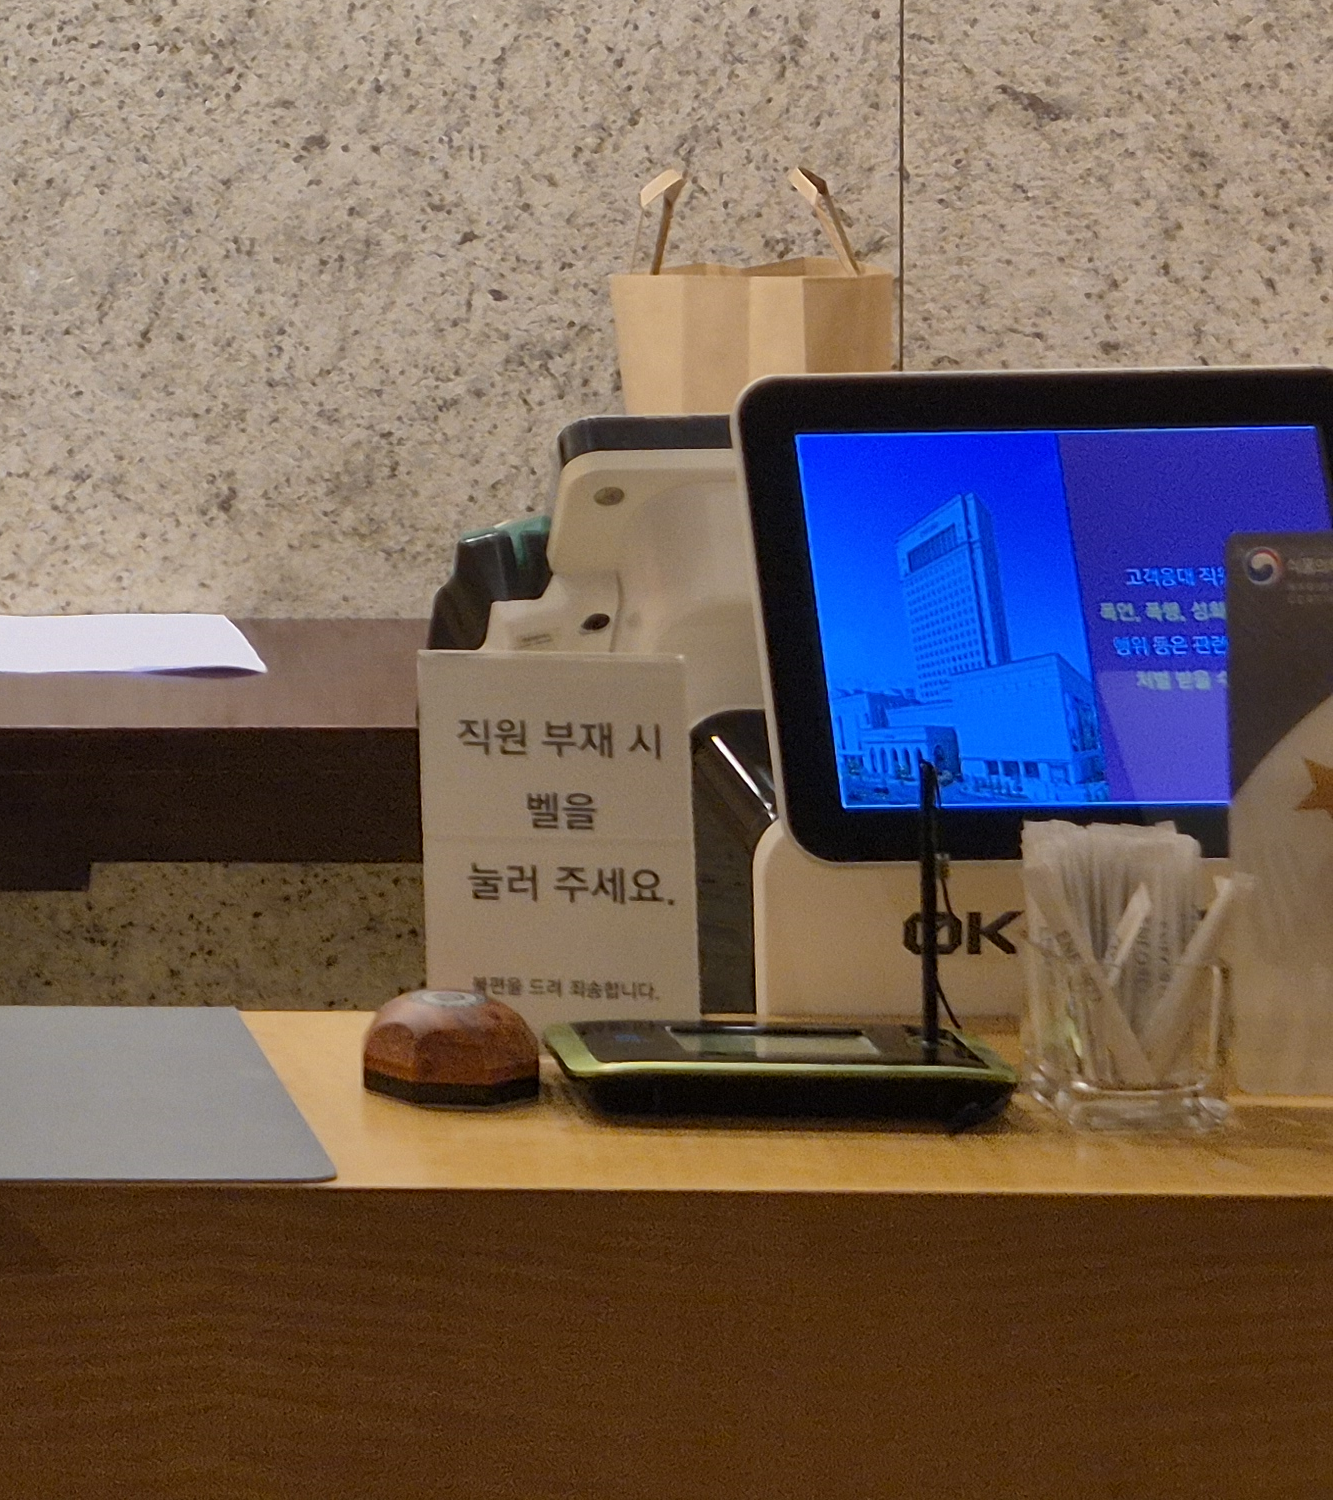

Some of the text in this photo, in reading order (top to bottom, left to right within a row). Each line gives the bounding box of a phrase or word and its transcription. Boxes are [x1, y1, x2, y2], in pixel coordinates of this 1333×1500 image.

[456, 718, 663, 760] 직원 부재 시
[527, 791, 597, 831] 벨을
[467, 862, 675, 906] 눌러 주세요.
